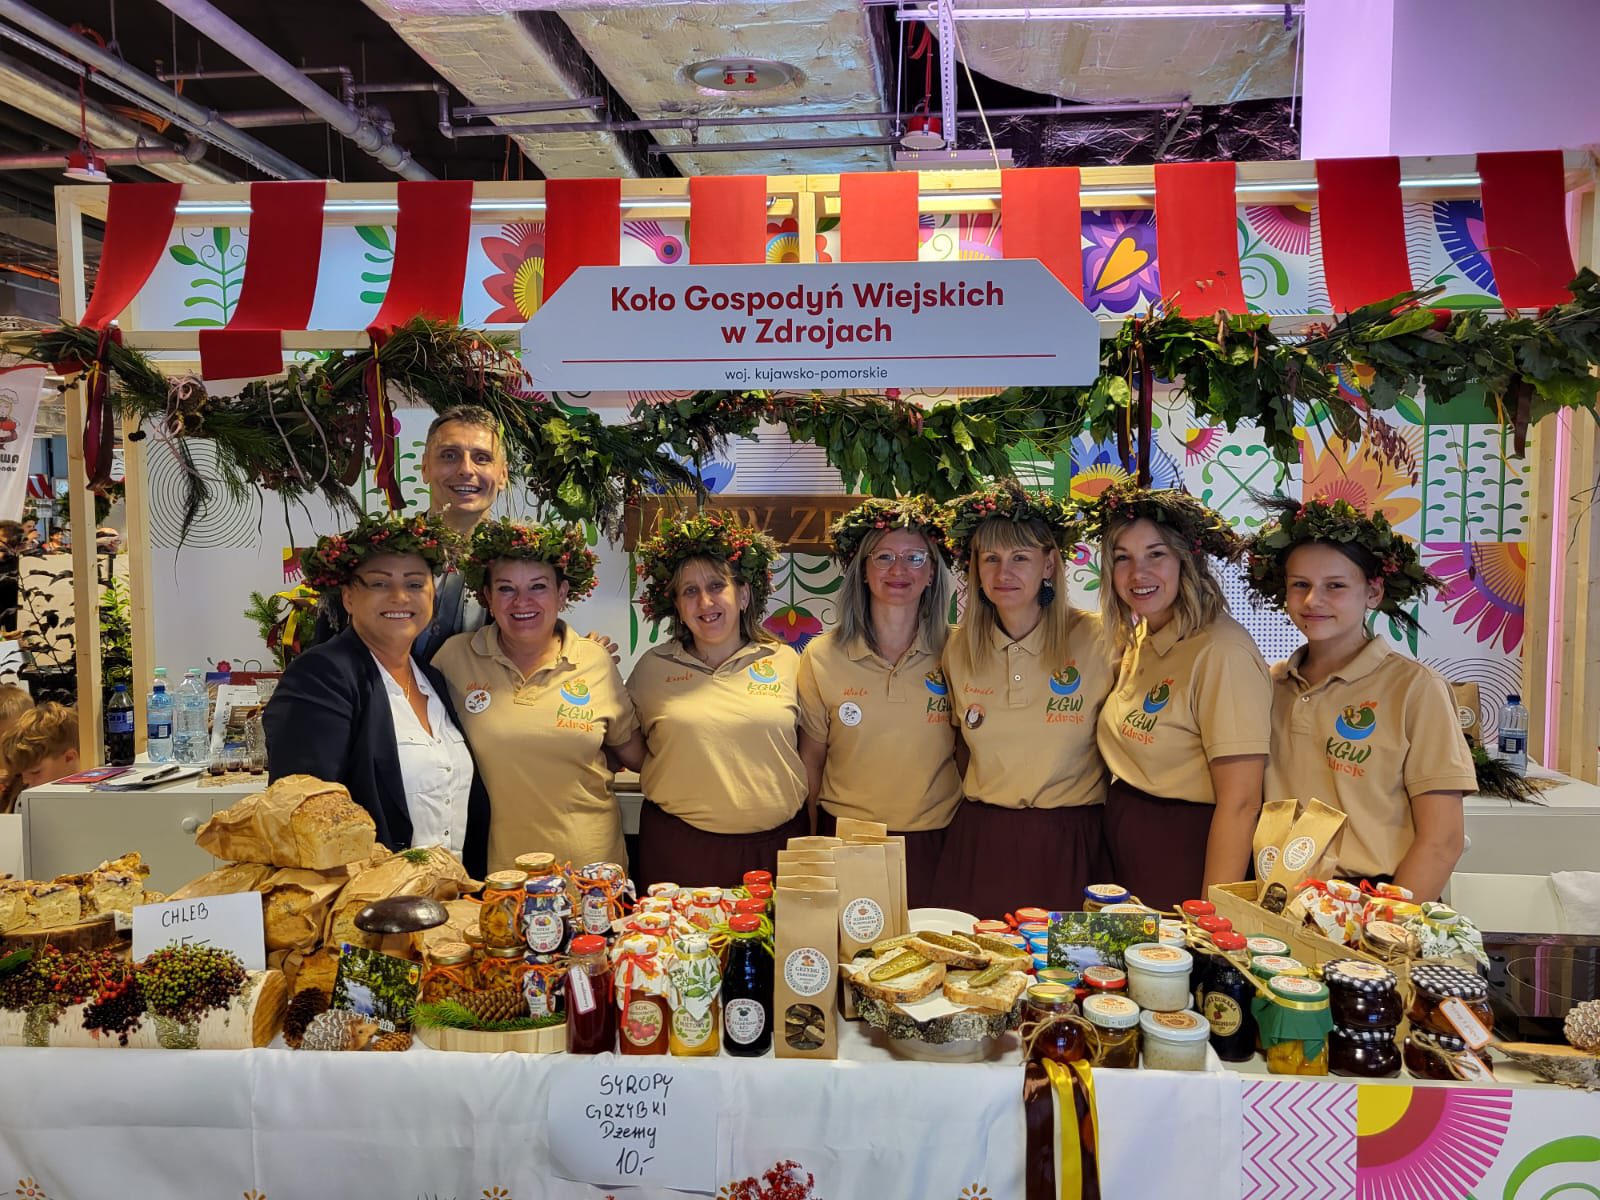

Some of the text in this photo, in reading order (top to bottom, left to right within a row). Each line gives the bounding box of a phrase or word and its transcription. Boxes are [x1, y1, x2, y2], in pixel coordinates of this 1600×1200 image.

[611, 280, 1004, 317] Koło Gospodyń Wiejskich
[720, 316, 892, 350] w Zdrojach
[724, 365, 888, 383] woj. kujawsko-pomorskie
[557, 703, 594, 721] KGW
[1046, 695, 1083, 713] KGW
[1046, 713, 1084, 724] Zdroje
[1123, 709, 1158, 732] KGW
[1121, 723, 1155, 744] Zdroje
[1326, 736, 1371, 764] KGW
[161, 902, 209, 928] CHLEB
[599, 1072, 674, 1099] SYROPY
[585, 1100, 667, 1120] GRZYBKI
